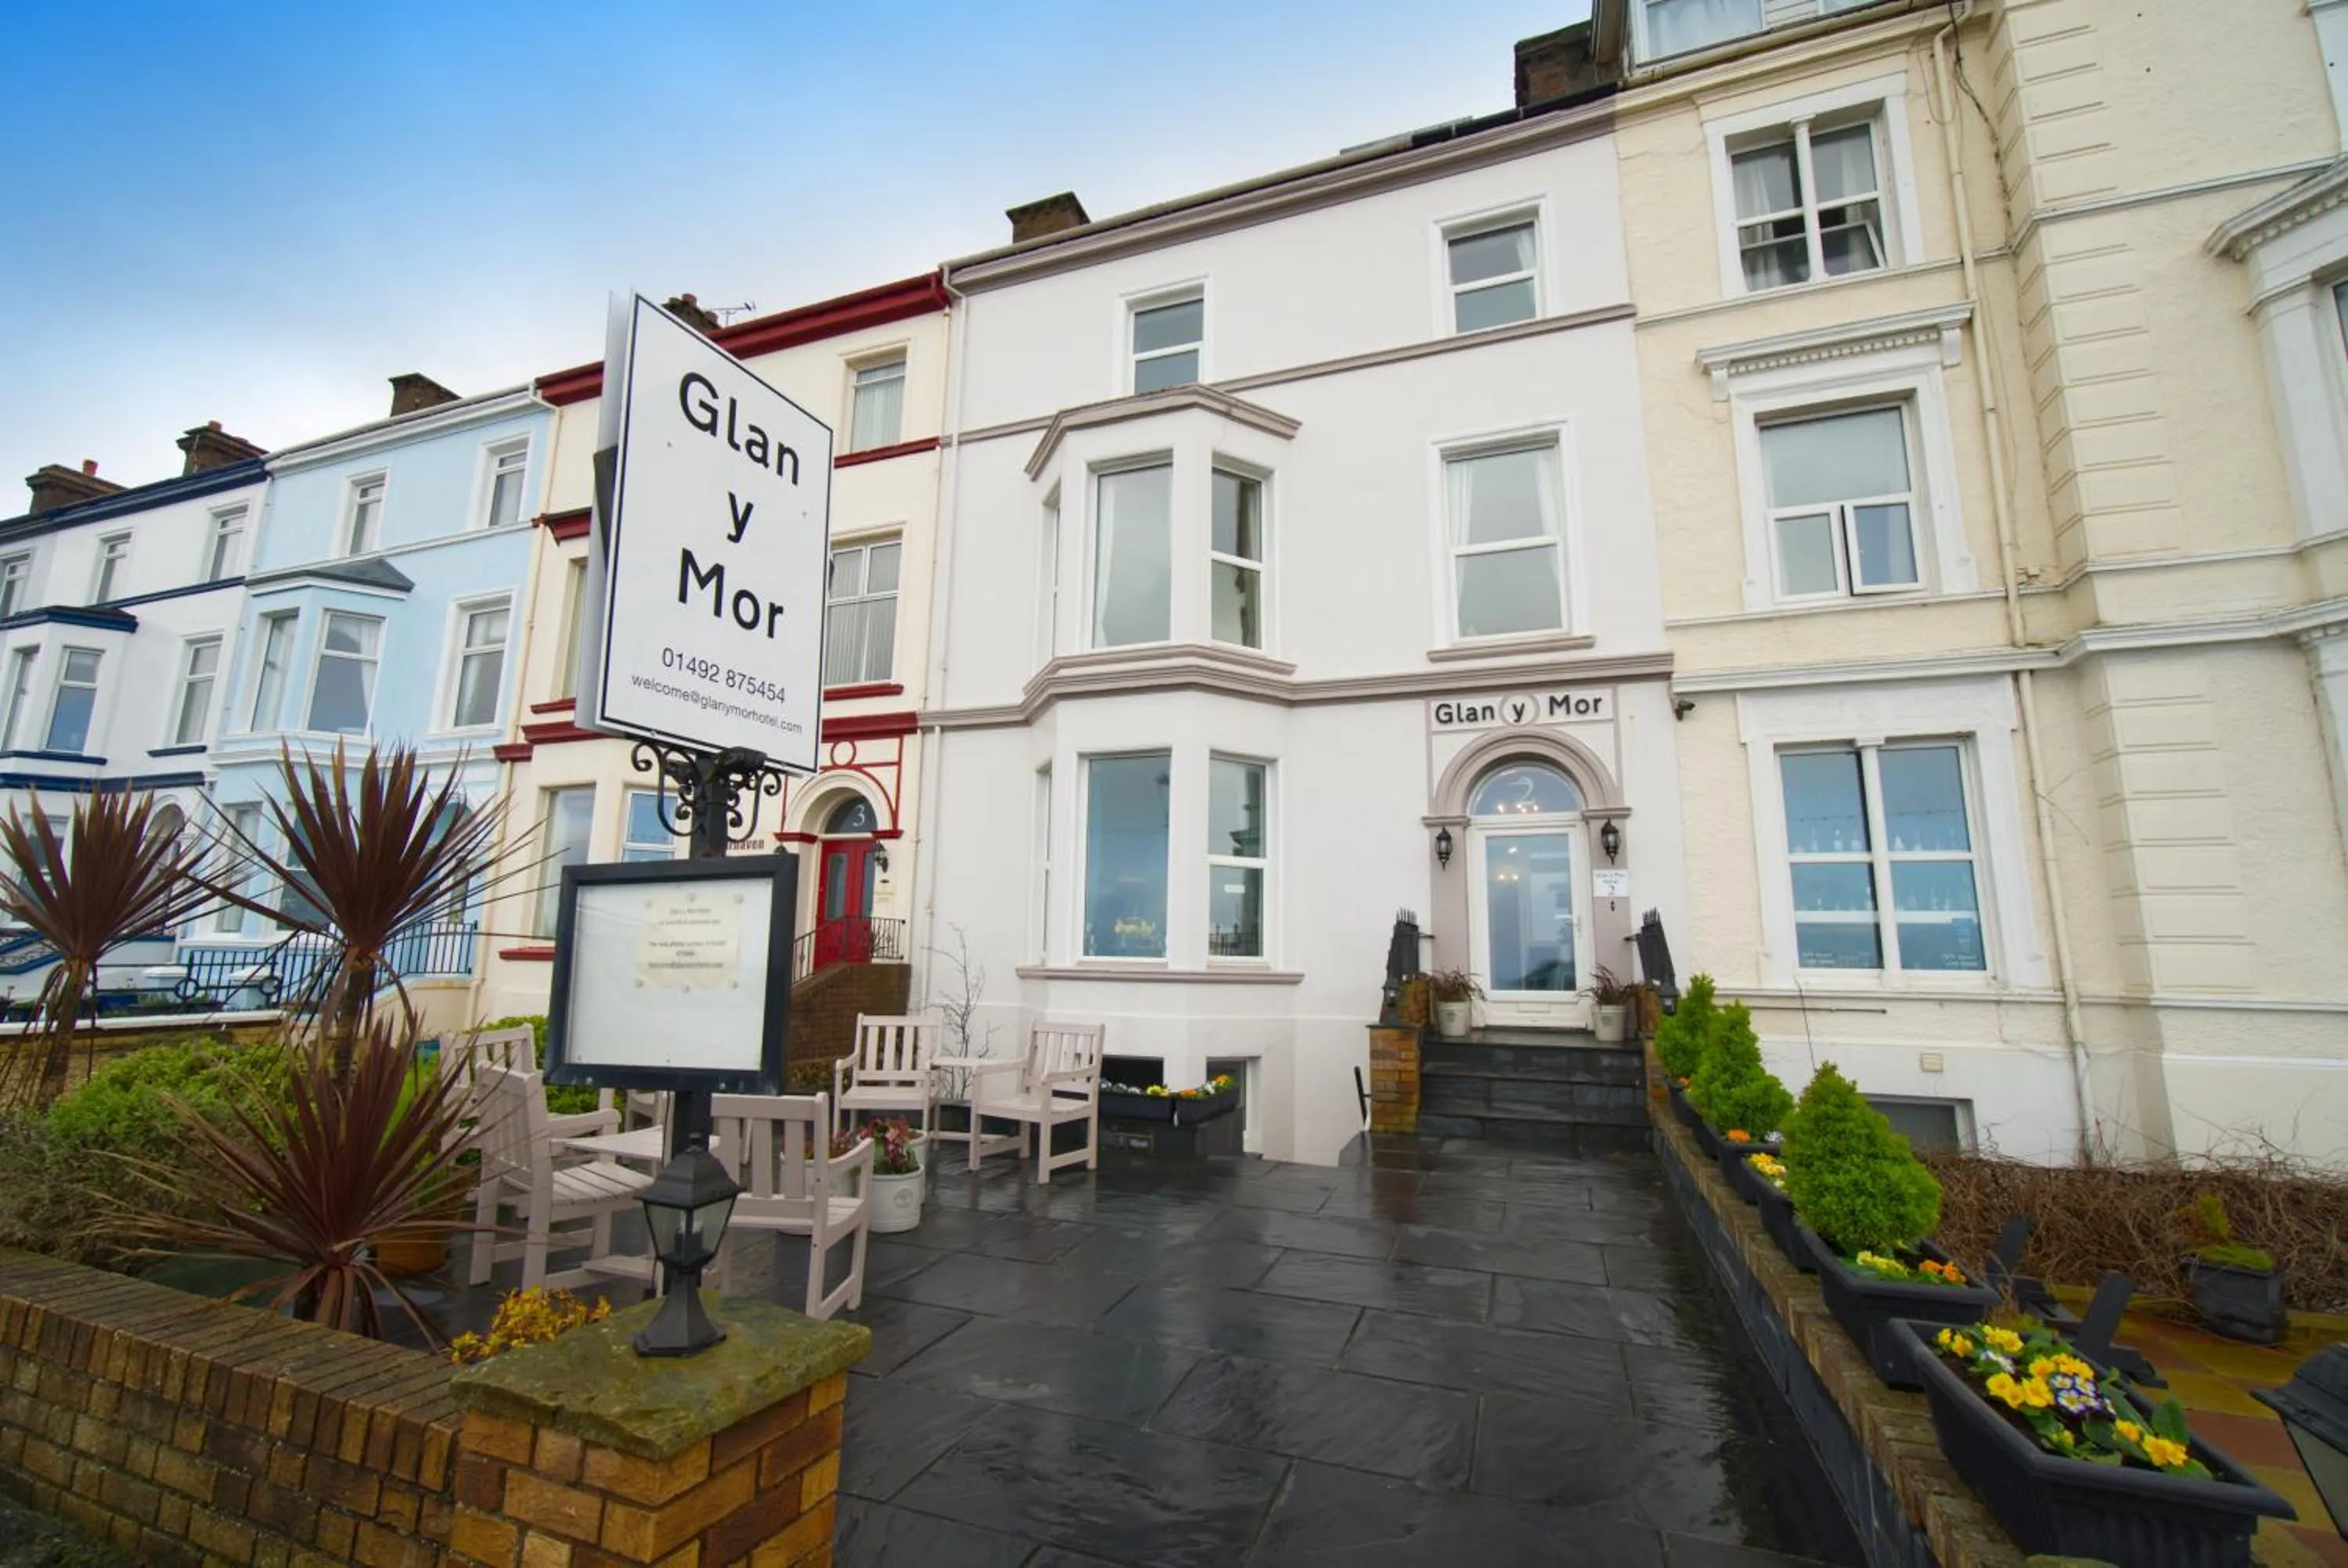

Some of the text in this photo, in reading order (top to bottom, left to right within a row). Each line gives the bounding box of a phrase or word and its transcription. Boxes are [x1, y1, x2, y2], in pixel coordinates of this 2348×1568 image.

[679, 372, 799, 487] Glan
[727, 490, 754, 544] y
[679, 547, 784, 639] Mor
[662, 647, 785, 703] 01492 875454
[632, 674, 802, 733] welcome@glanymorhotel.com
[1435, 694, 1602, 725] Glan y Mor
[852, 804, 865, 827] 3
[1508, 776, 1536, 804] 2
